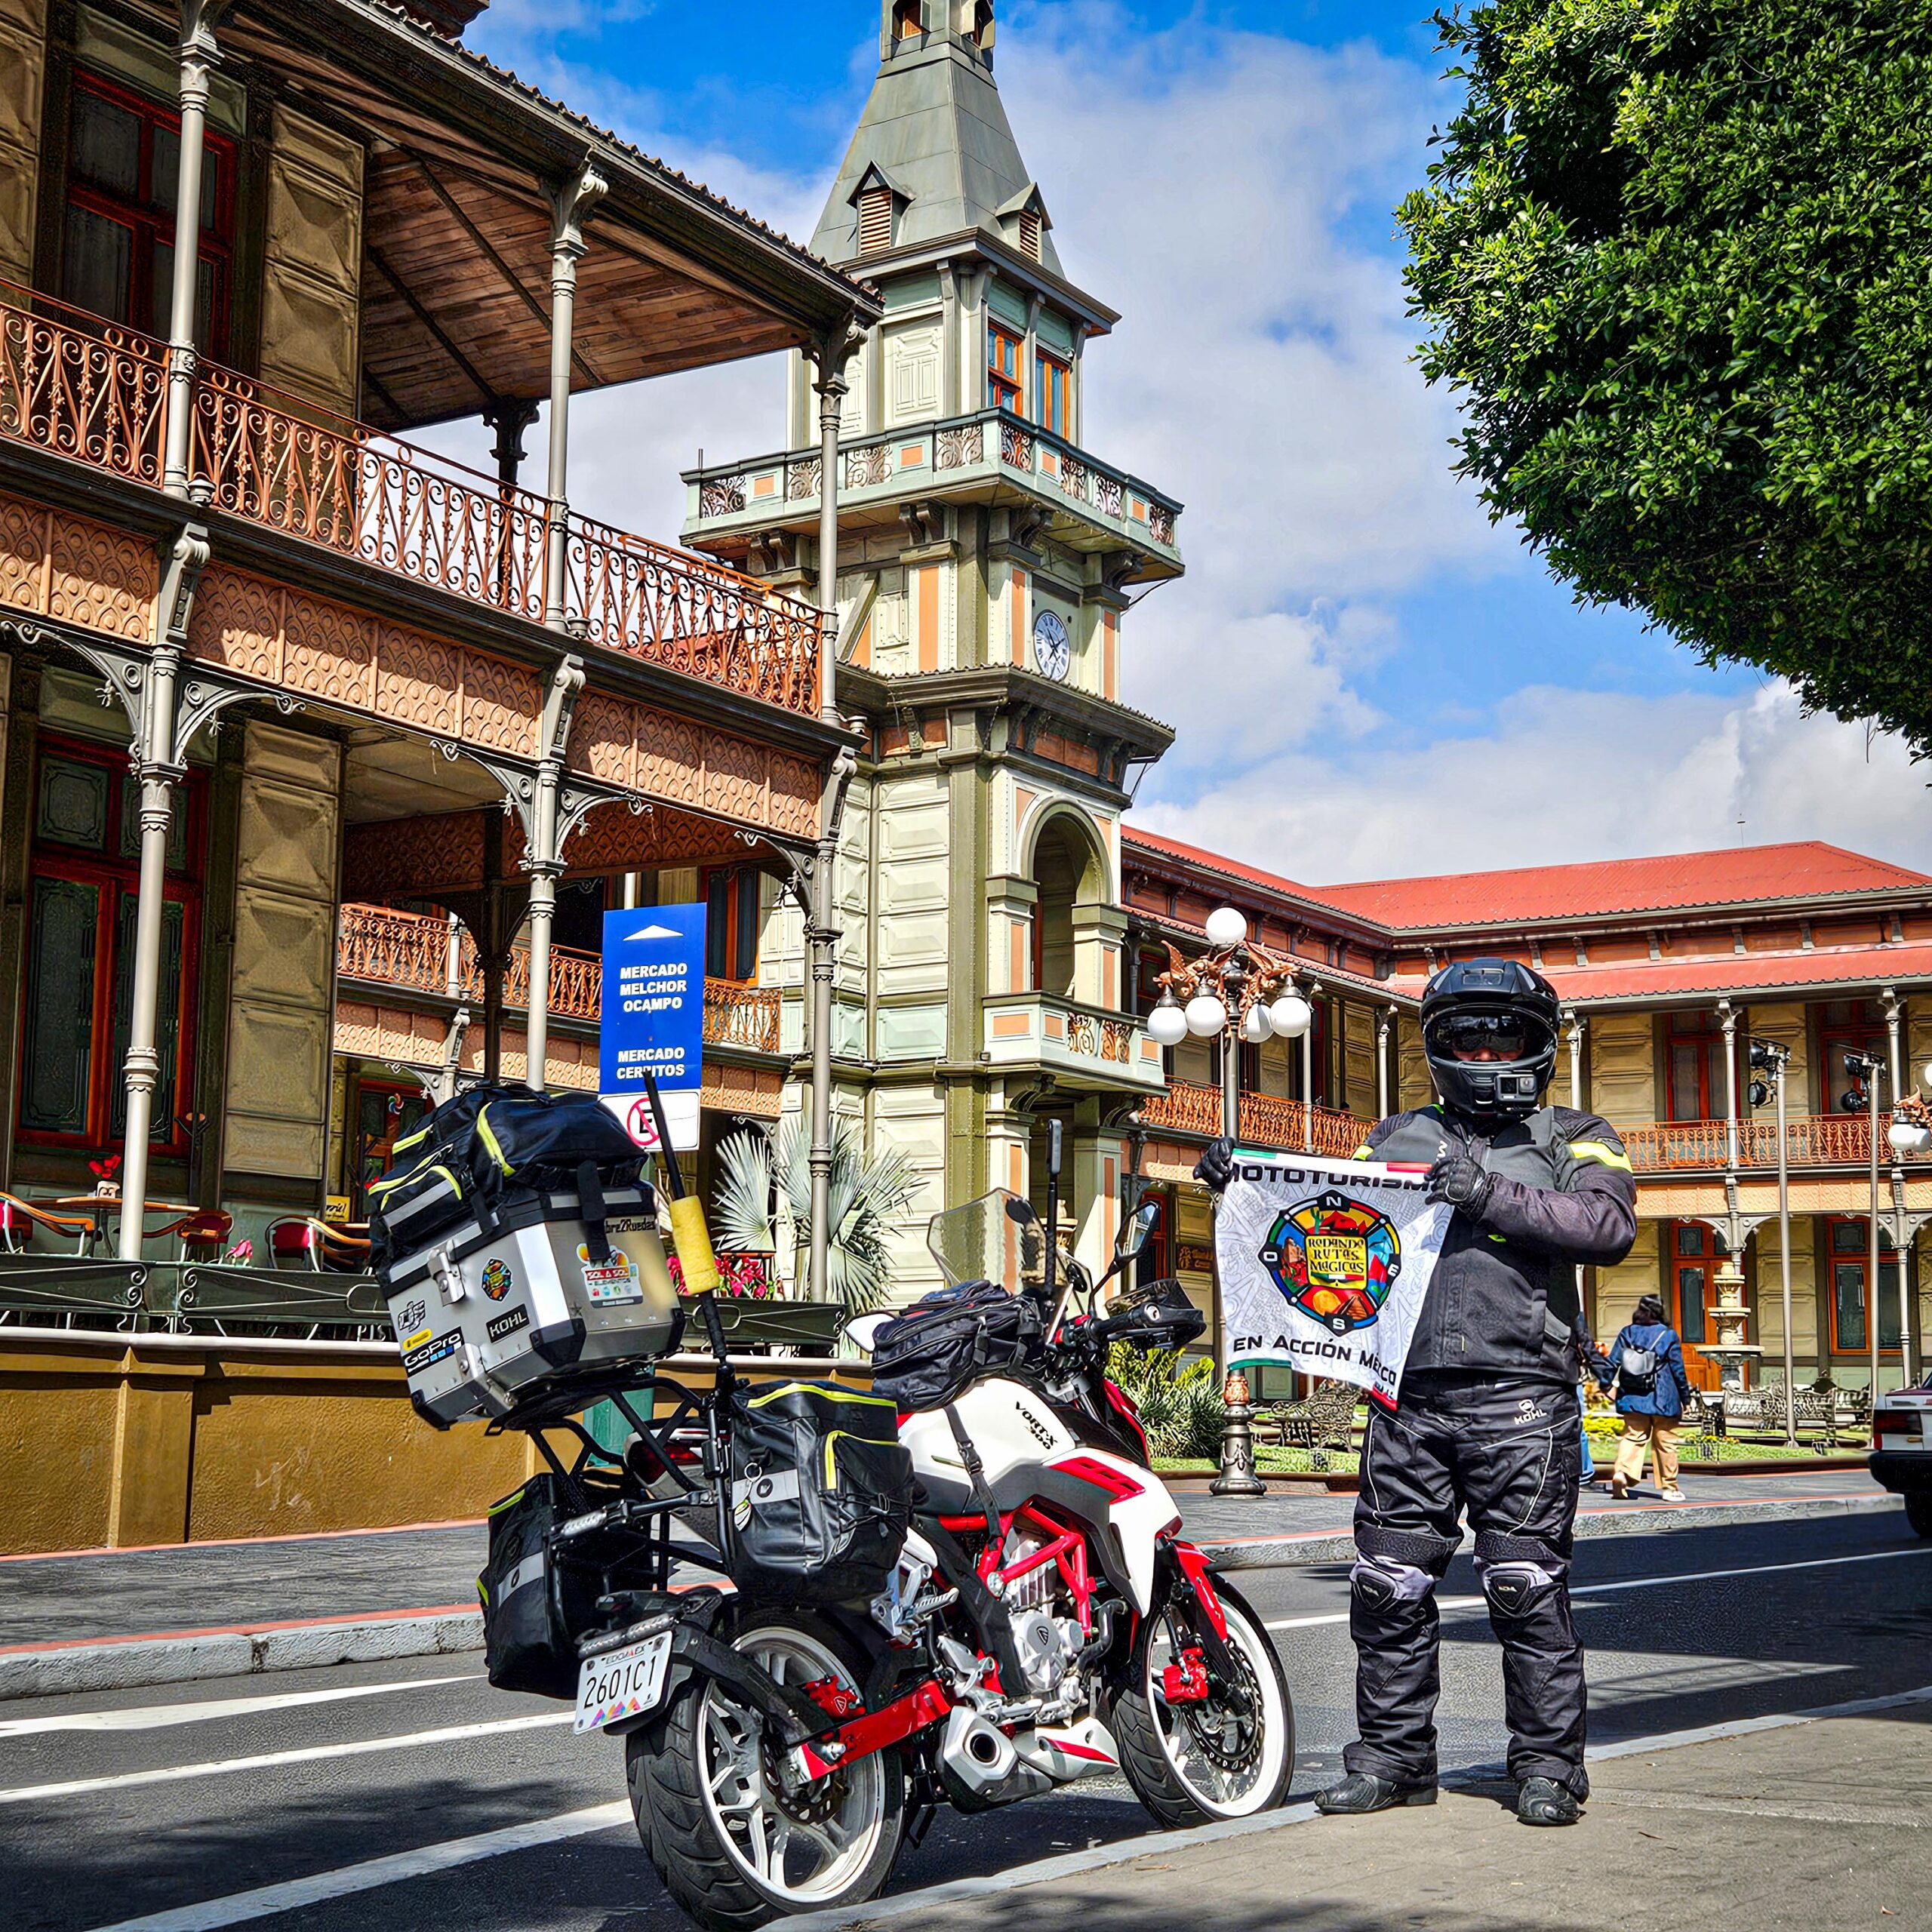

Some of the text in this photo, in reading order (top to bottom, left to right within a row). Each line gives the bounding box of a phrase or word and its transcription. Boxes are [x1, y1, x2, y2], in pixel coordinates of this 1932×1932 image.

[620, 962, 688, 980] MERCADO
[619, 980, 687, 996] MELCHOR
[623, 996, 682, 1013] OCAMPO
[617, 1047, 685, 1063] MERCADO
[1232, 1162, 1436, 1192] OTOTURISM
[1326, 1195, 1342, 1207] N
[1387, 1263, 1400, 1277] E
[489, 1312, 527, 1337] KOHL
[1333, 1317, 1346, 1330] S
[404, 1333, 461, 1367] GoPro
[1233, 1335, 1263, 1352] EN
[1272, 1334, 1352, 1361] ACCIÓN
[1514, 1408, 1547, 1426] KOHL
[583, 1655, 657, 1709] 2601C1
